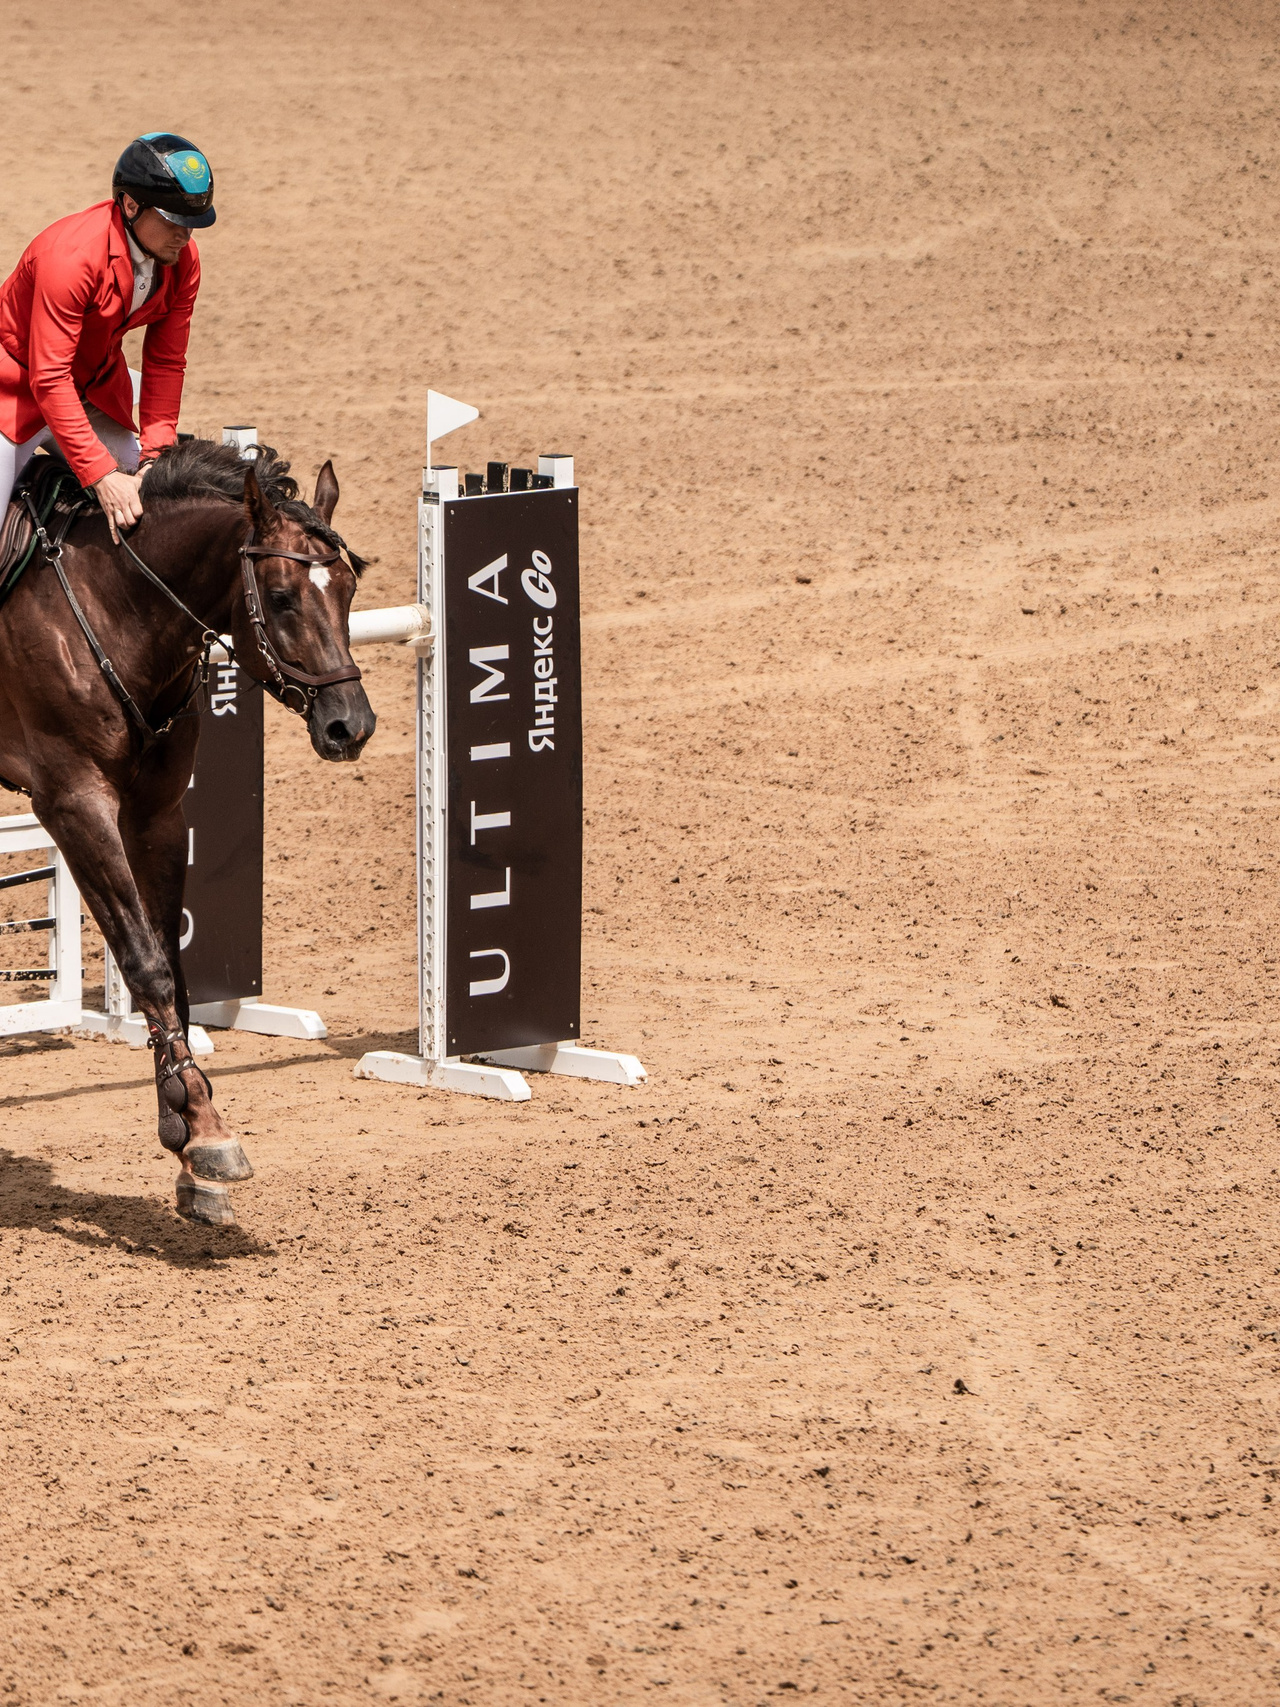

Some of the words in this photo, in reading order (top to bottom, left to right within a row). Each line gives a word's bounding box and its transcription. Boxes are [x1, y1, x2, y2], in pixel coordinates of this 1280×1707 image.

[520, 549, 557, 609] Go
[528, 615, 559, 753] Яндекс
[467, 552, 511, 997] ULTIMA
